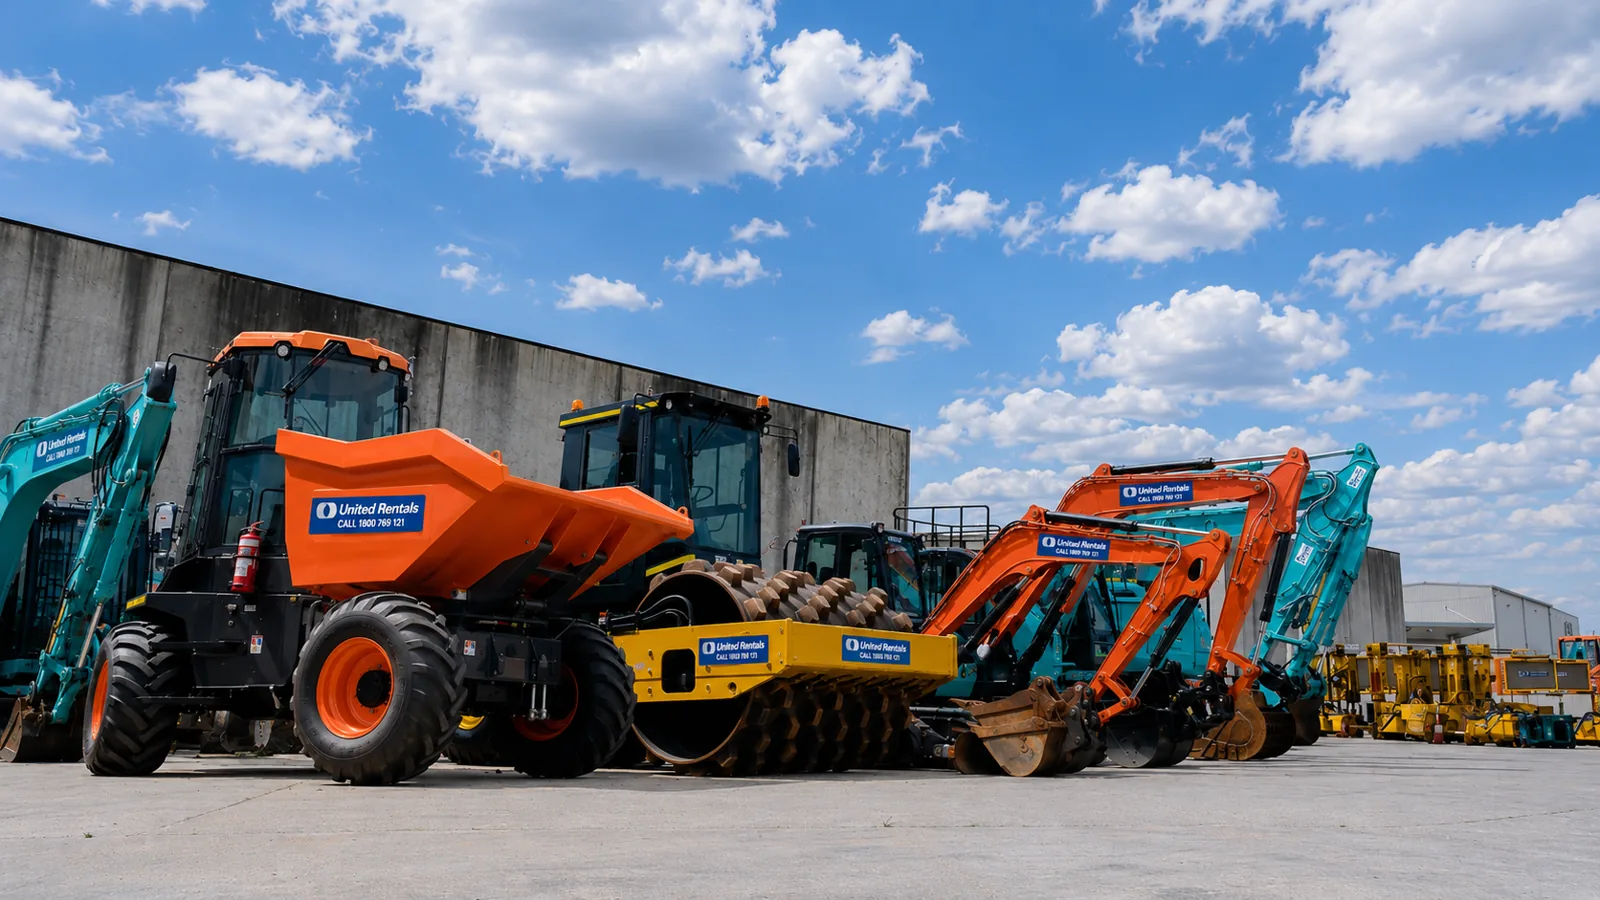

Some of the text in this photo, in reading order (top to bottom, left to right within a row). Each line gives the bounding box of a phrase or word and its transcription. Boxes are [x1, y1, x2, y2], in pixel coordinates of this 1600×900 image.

[339, 502, 419, 515] United Rentals
[337, 519, 357, 528] CALL
[377, 518, 392, 528] 769
[393, 518, 405, 527] 121
[716, 640, 765, 652] United Rentals
[716, 653, 729, 661] CALL
